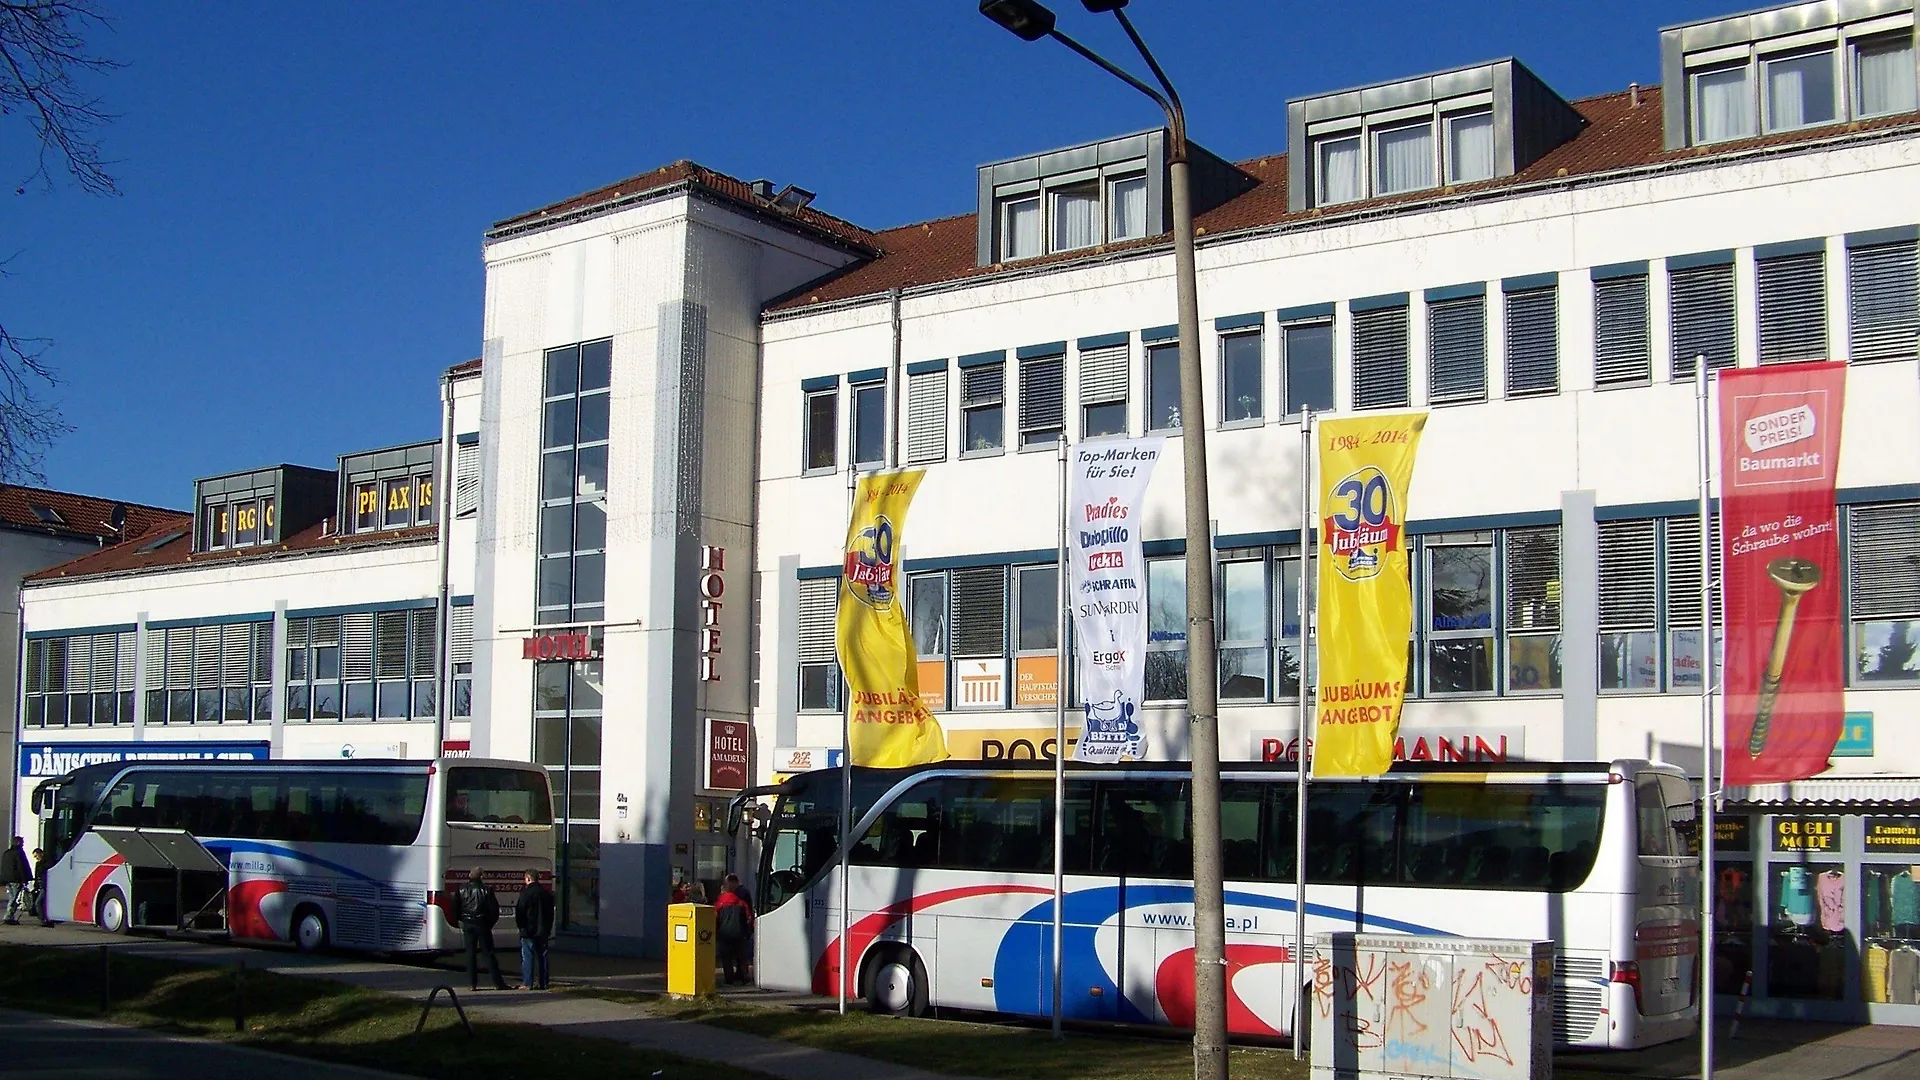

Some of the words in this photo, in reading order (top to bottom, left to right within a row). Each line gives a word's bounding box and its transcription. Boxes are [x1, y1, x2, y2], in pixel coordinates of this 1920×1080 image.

[1749, 410, 1807, 435] SONDER
[1328, 431, 1360, 451] 1984
[1371, 427, 1409, 445] 2014
[1759, 425, 1802, 446] PREIS!
[1078, 447, 1156, 465] Top-Marken
[1739, 452, 1821, 472] Baumarkt
[1086, 465, 1106, 479] für
[1108, 464, 1136, 479] Sie!
[1333, 474, 1388, 531] 30
[1741, 525, 1758, 538] da
[1760, 521, 1780, 533] wo
[1783, 515, 1802, 528] die
[1732, 533, 1790, 556] Schraube
[700, 544, 725, 682] HOTEL
[522, 633, 592, 660] HOTEL
[1019, 673, 1034, 681] DER
[714, 735, 744, 753] HOTEL
[712, 753, 746, 764] AMADEUS
[499, 836, 525, 849] Milla
[1142, 912, 1258, 931] www.a.pl
